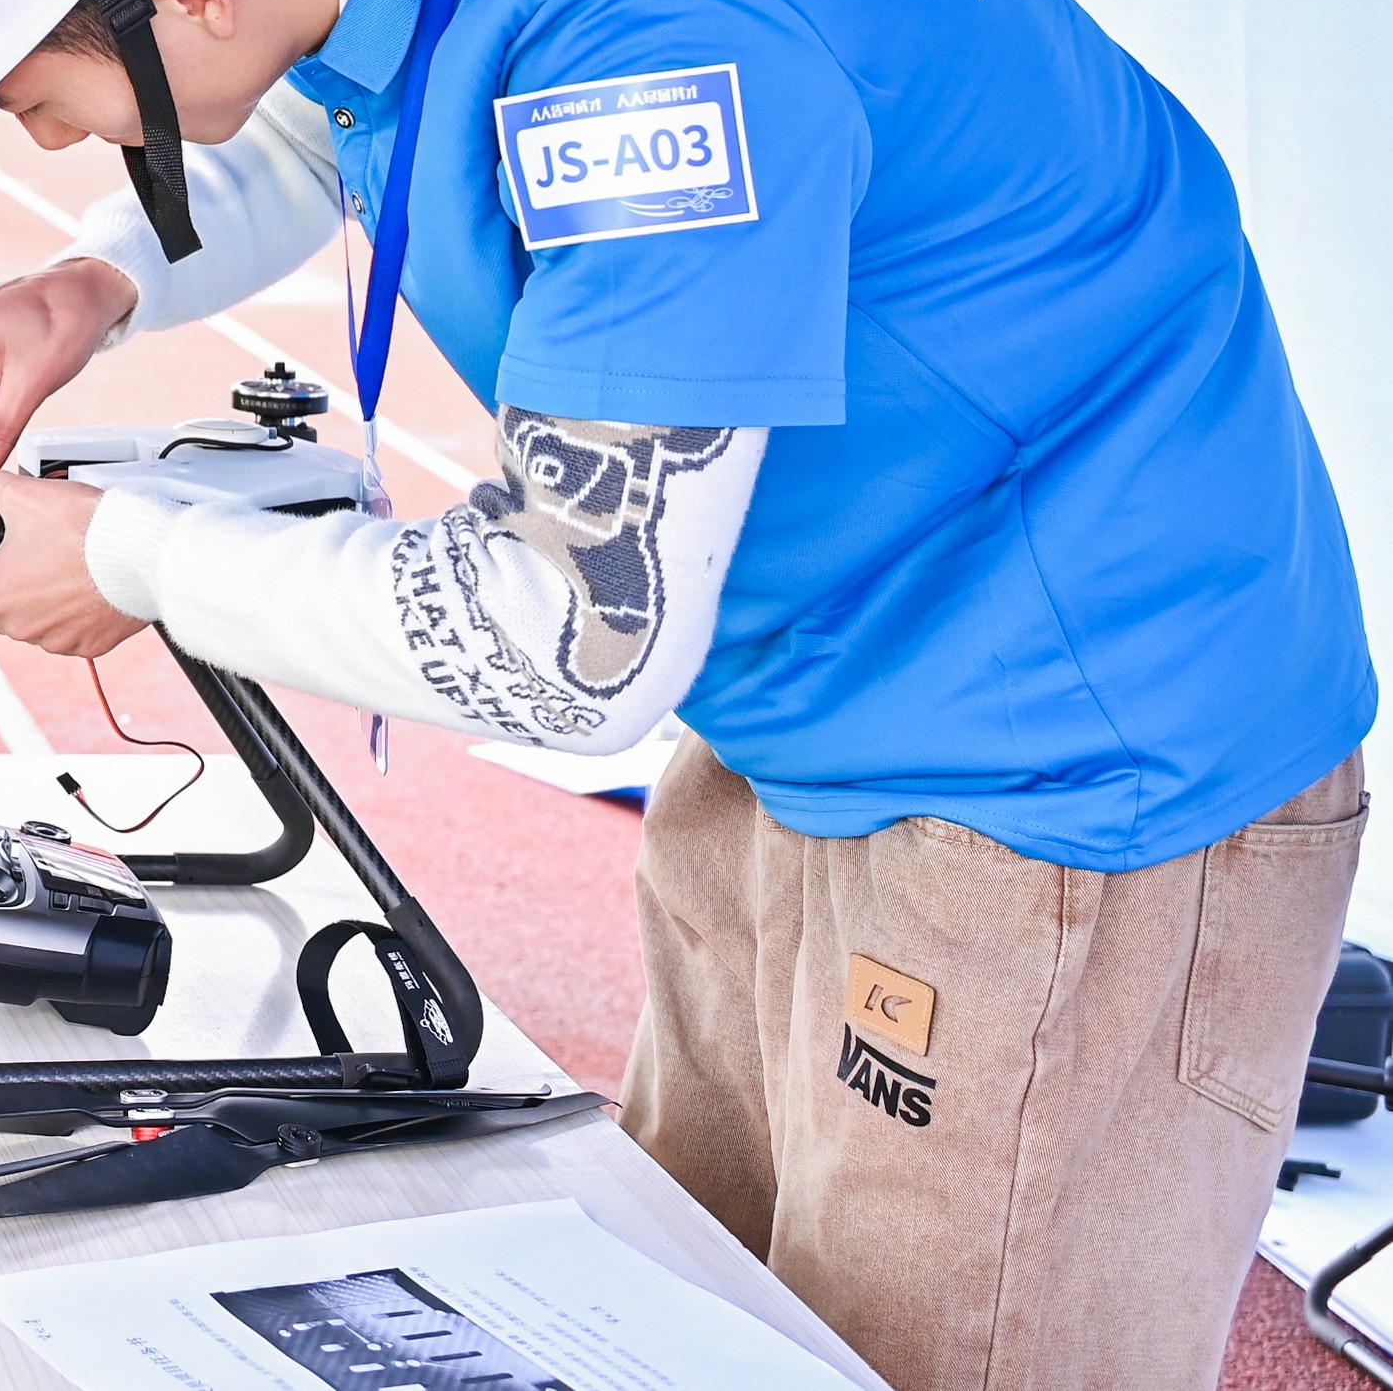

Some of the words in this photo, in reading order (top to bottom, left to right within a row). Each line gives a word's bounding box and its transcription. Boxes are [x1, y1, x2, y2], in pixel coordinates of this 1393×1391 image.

[530, 97, 602, 123] 人人皆可成才
[535, 123, 713, 189] JS-A03
[836, 1021, 937, 1128] VANS
